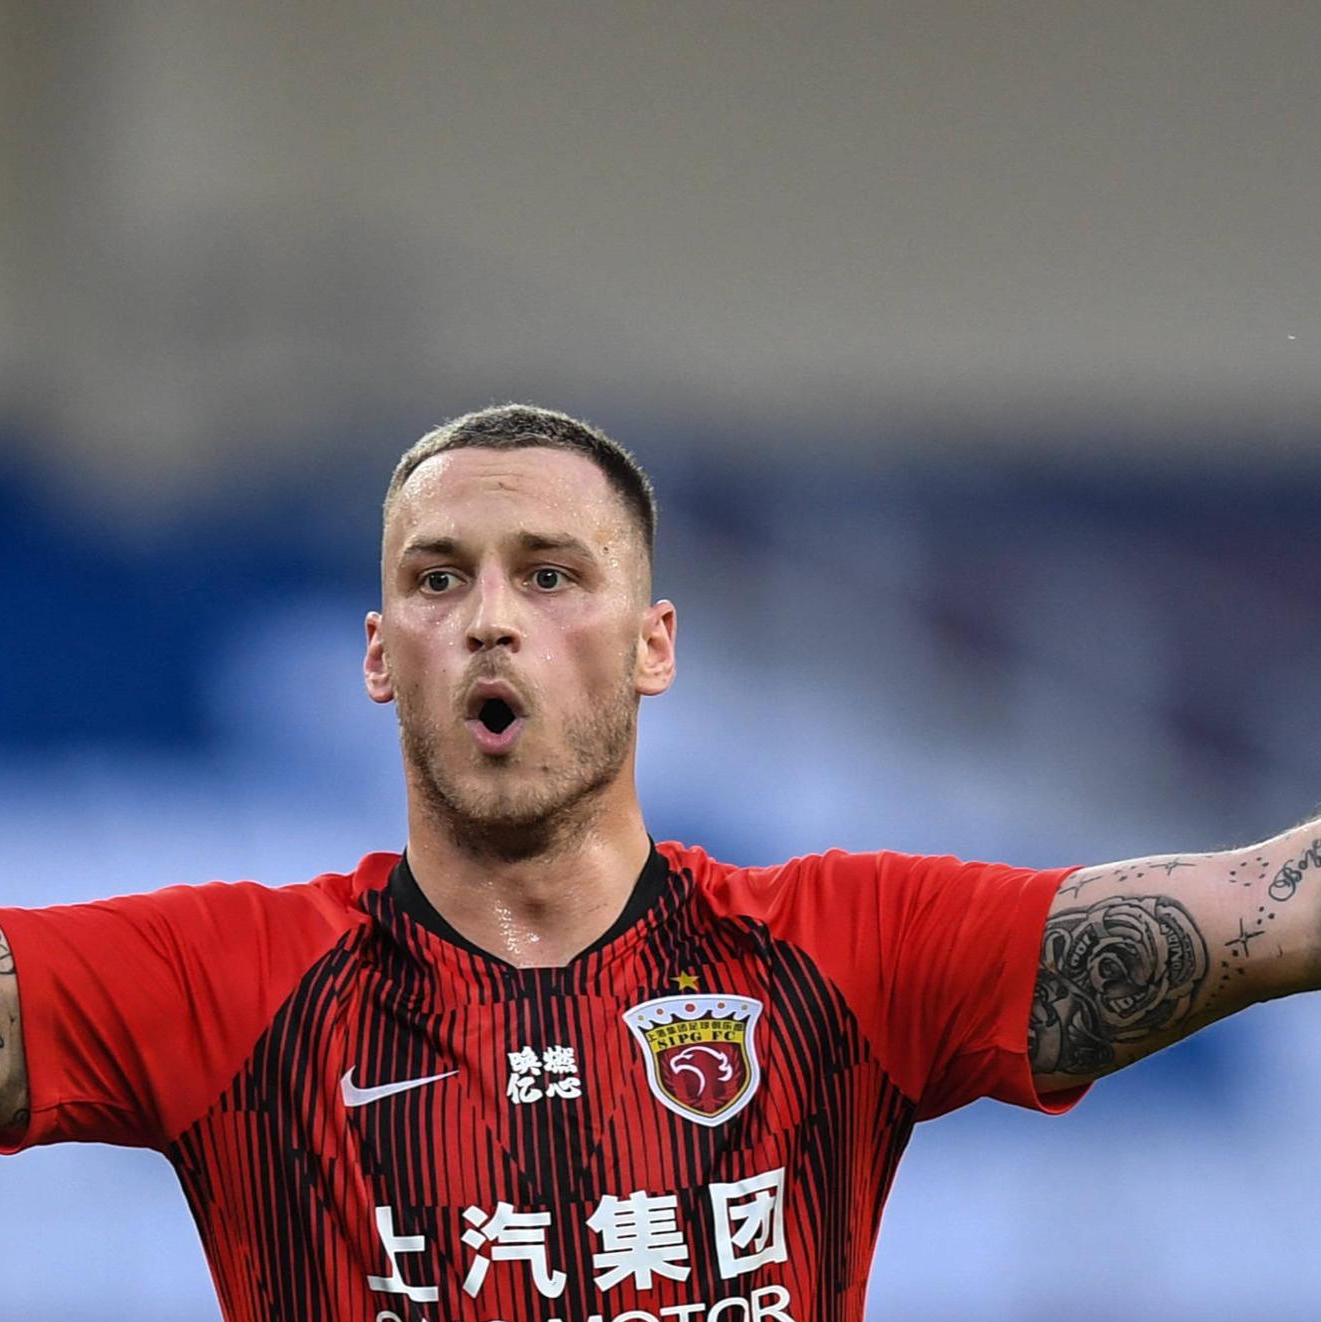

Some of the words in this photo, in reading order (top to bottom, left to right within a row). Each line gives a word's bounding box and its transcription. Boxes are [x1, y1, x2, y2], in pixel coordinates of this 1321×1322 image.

[657, 1031, 702, 1050] SIPG
[712, 1031, 736, 1041] FC
[369, 1167, 787, 1302] 上汽集团
